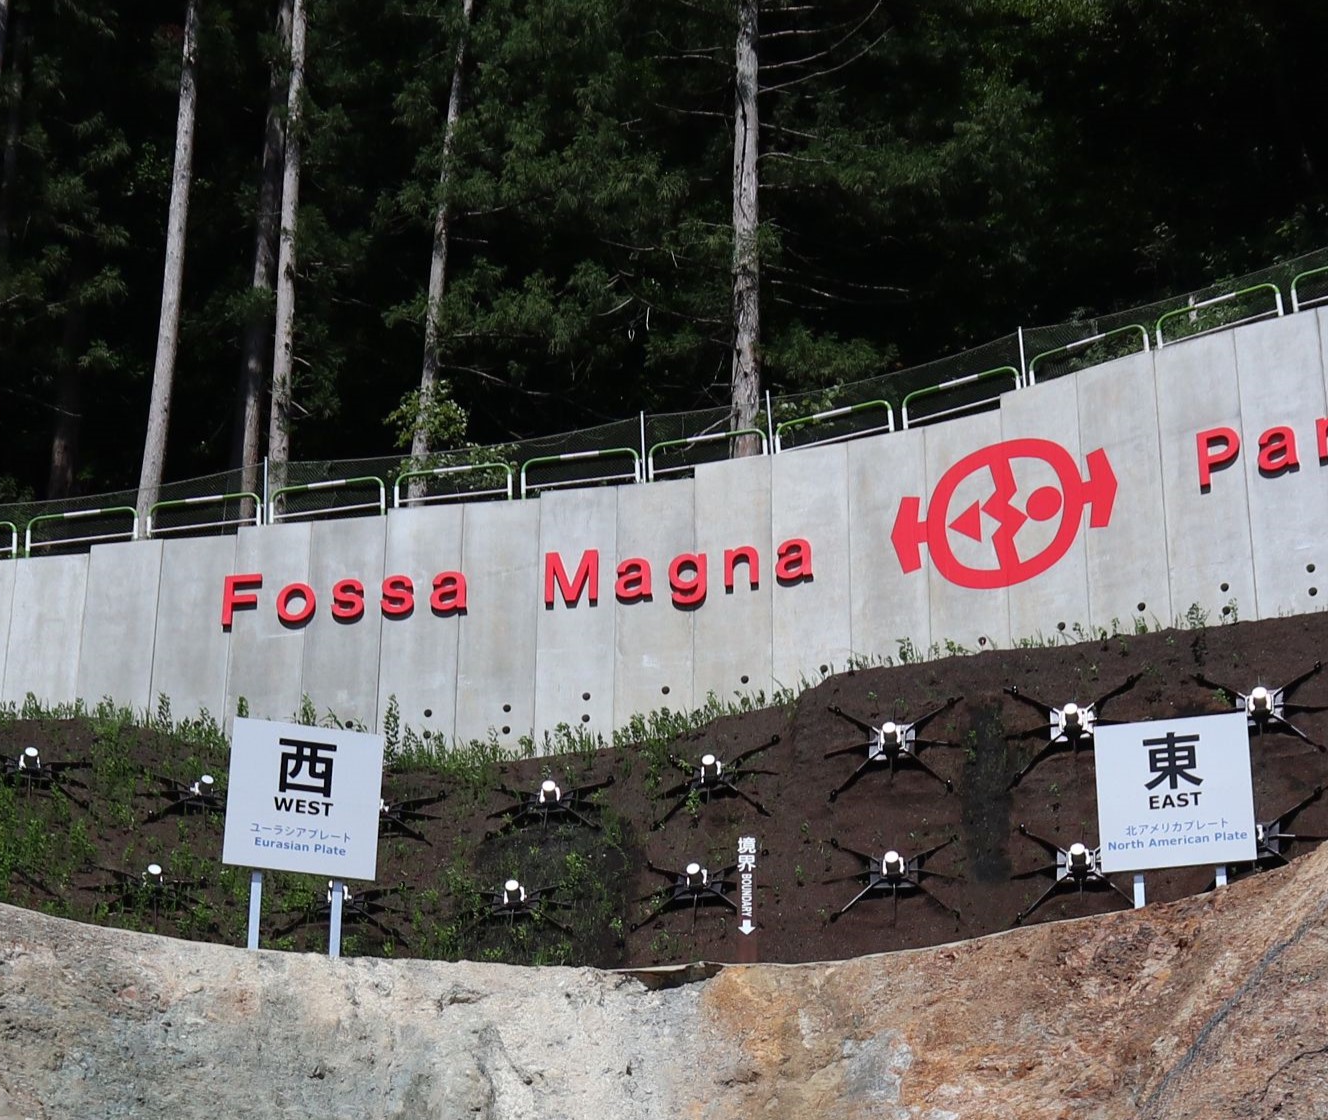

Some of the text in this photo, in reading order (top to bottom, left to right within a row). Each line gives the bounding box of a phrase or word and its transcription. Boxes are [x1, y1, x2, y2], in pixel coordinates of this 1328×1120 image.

[221, 571, 468, 631] Fossa
[544, 538, 814, 611] Magna
[279, 738, 337, 798] 西
[1142, 732, 1204, 791] 東
[274, 796, 334, 817] WEST
[1149, 791, 1202, 810] EAST
[250, 822, 351, 844] ユーラシアプレート
[1126, 817, 1229, 837] 北アメリカプレート
[254, 836, 347, 856] Eurasian Plate
[1108, 830, 1248, 851] North American Plate
[737, 836, 756, 872] 境界
[741, 873, 753, 917] BOUNDARY
